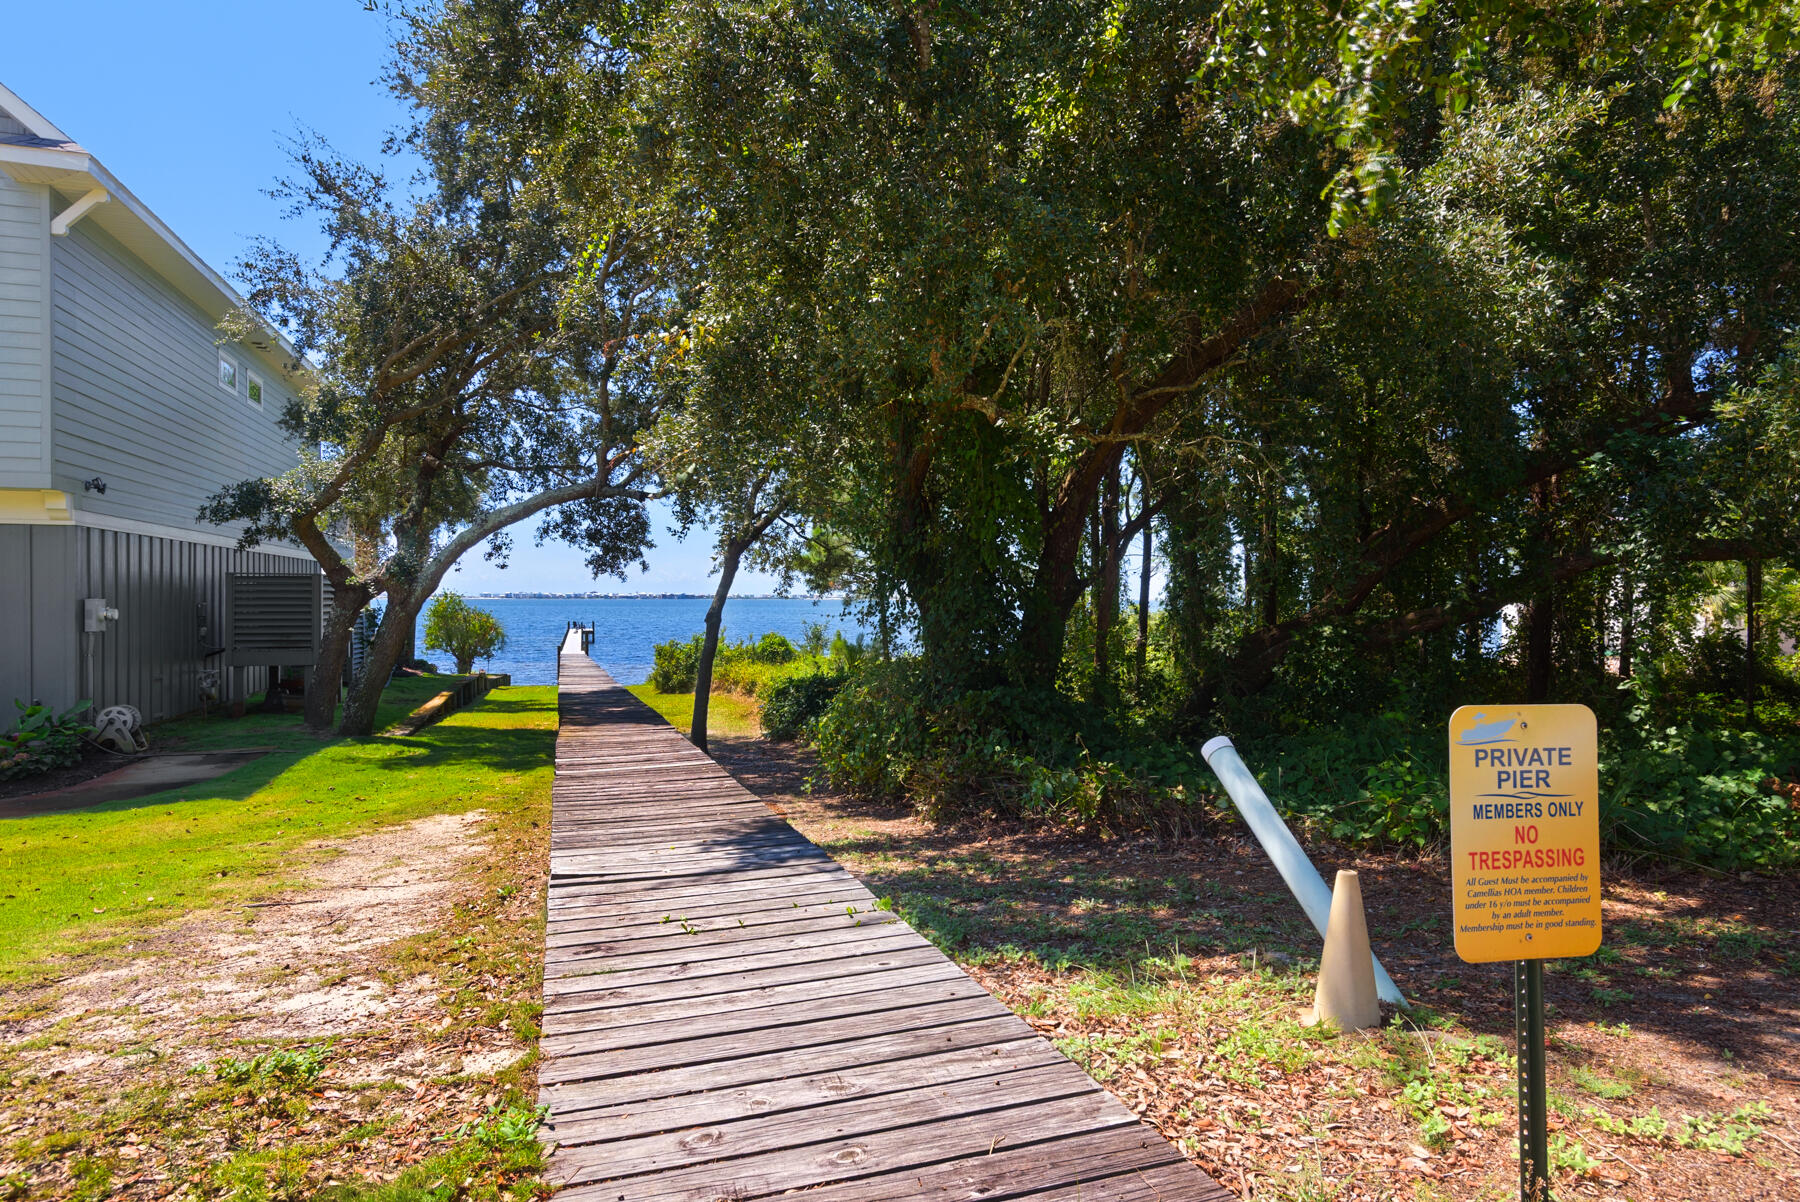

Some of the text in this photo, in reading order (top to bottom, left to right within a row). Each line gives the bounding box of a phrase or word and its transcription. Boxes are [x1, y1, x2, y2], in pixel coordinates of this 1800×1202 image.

[1475, 747, 1572, 767] PRIVATE
[1498, 770, 1551, 789] PIER
[1473, 801, 1584, 820] MEMBERS ONLY
[1515, 825, 1538, 844] NO
[1469, 848, 1584, 870] TRESPASSING
[1466, 878, 1476, 886] All
[1478, 878, 1498, 886] Guest
[1520, 875, 1529, 883] be
[1531, 874, 1578, 884] accompanied
[1581, 873, 1588, 882] by
[1467, 888, 1502, 897] Camellias
[1524, 887, 1554, 895] member.
[1557, 885, 1588, 893] Children
[1465, 896, 1591, 909] under 16 y/o must be accompanied
[1492, 911, 1500, 919] by
[1514, 910, 1531, 918] adult
[1533, 909, 1564, 917] member.
[1460, 923, 1504, 933] Membership
[1506, 922, 1523, 930] must
[1544, 919, 1563, 930] good
[1565, 917, 1596, 929] standing.
